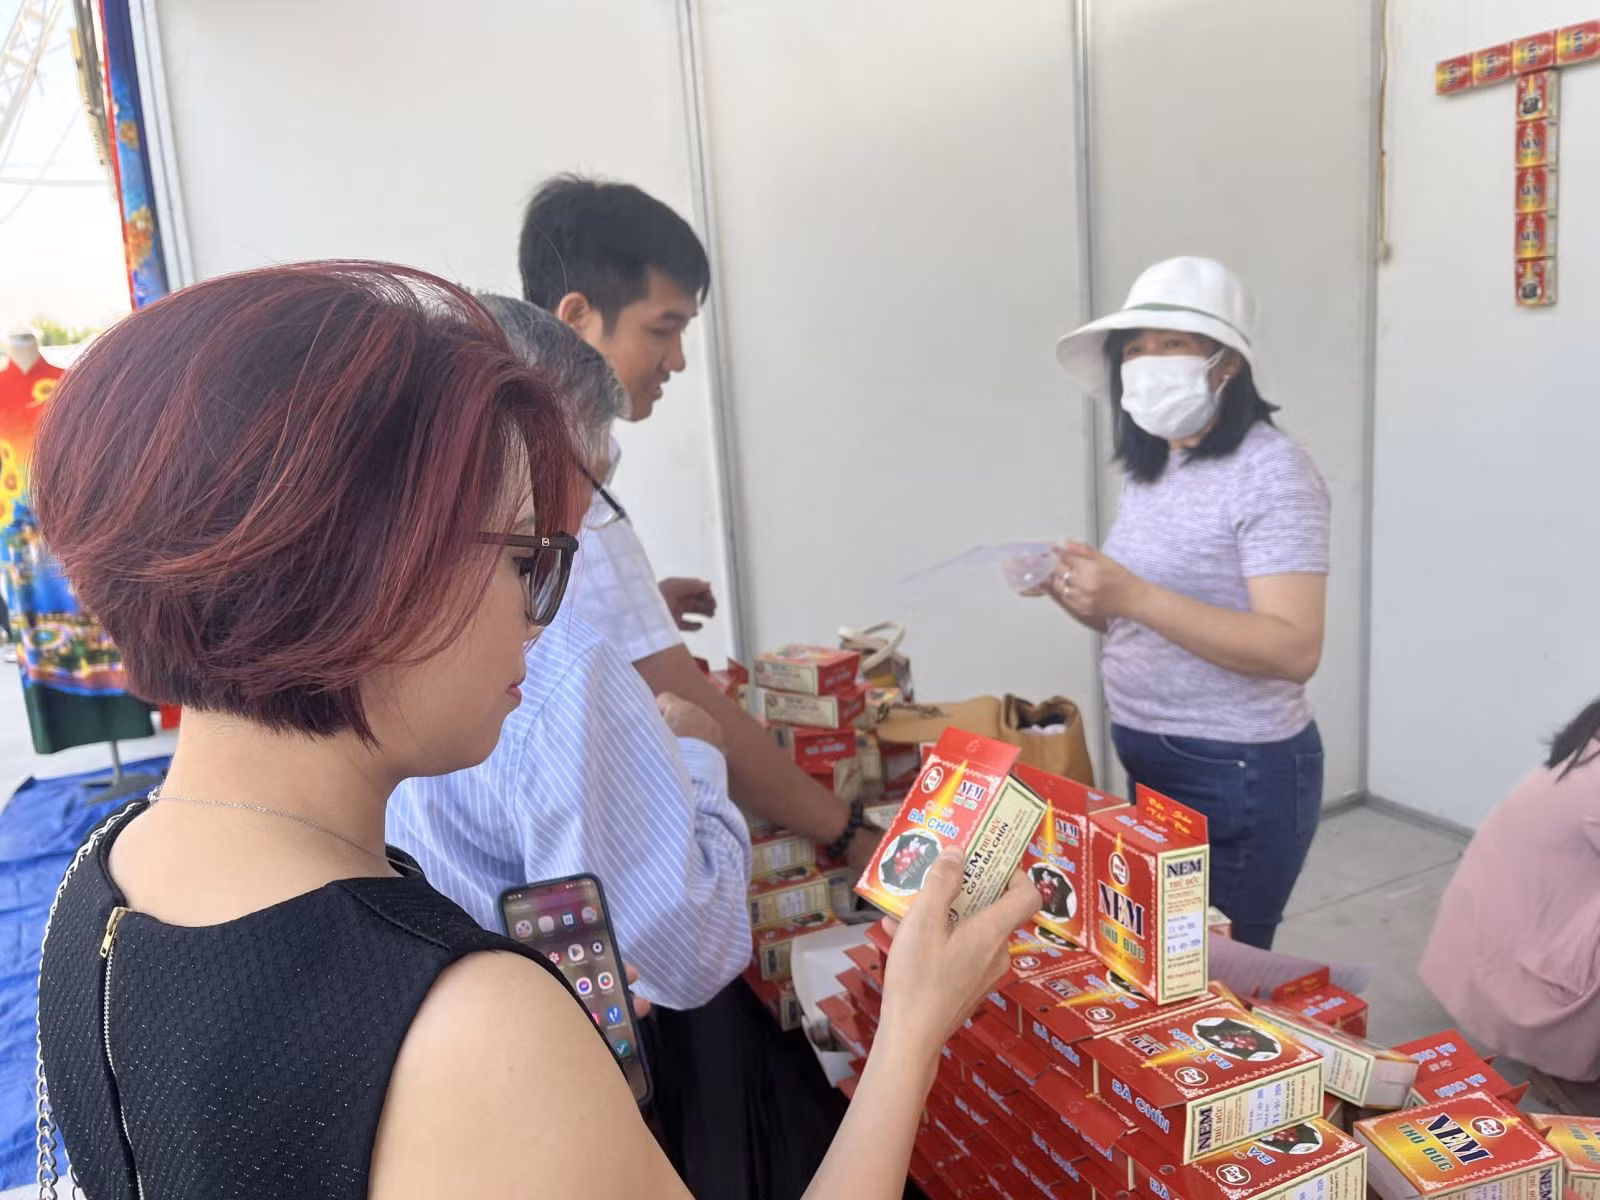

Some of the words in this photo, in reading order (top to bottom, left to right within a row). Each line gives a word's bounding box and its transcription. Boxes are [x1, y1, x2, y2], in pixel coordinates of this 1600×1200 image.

[908, 808, 926, 824] BÀ
[1167, 858, 1203, 878] NEM
[1098, 880, 1145, 940] NEM
[1112, 1078, 1133, 1104] BÀ
[1135, 1097, 1170, 1134] CHÍN
[1198, 1105, 1213, 1152] NEM
[1247, 1145, 1276, 1165] BÀ
[1417, 1112, 1494, 1165] NEM
